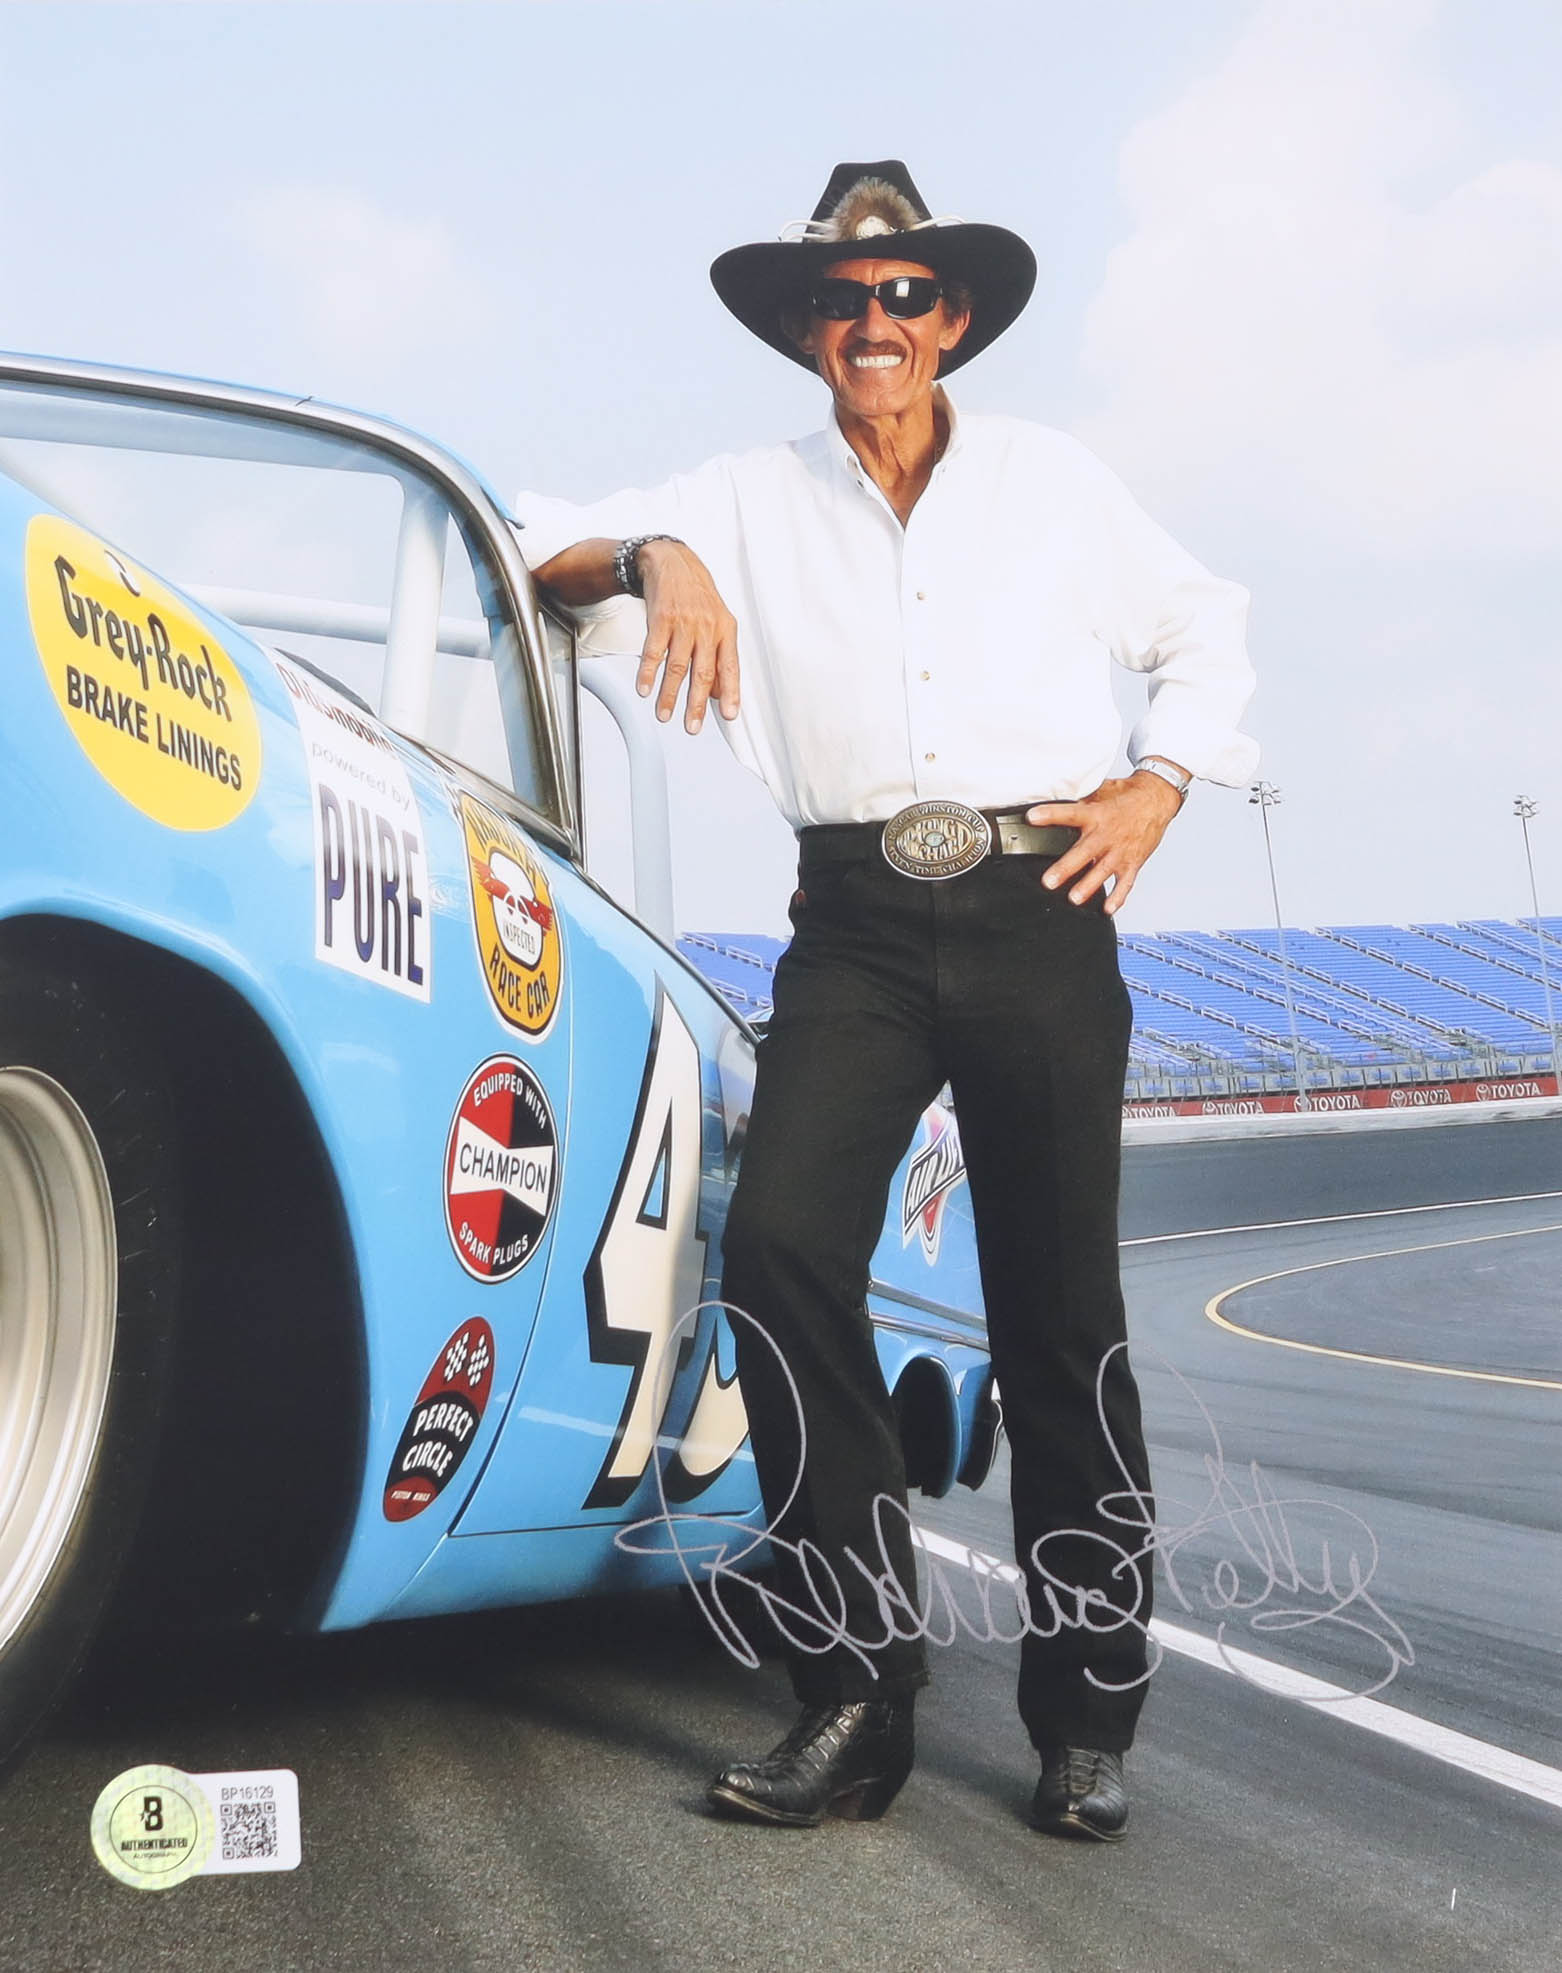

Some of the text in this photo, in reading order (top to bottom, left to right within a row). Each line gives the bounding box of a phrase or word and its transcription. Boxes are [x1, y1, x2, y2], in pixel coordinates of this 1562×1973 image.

[67, 664, 242, 791] BRAKE LININGS
[312, 743, 411, 811] powered by
[319, 783, 424, 986] PURE
[503, 920, 537, 956] INSPECTED
[489, 942, 551, 1019] RACE CAR
[474, 1073, 547, 1129] EQUIPPED WITH
[1216, 1101, 1265, 1114] TOYOTA
[1311, 1095, 1361, 1110] TOYOTA
[1406, 1088, 1452, 1105] TOYOTA
[1490, 1082, 1542, 1098] TOYOTA
[459, 1143, 548, 1194] CHAMPION
[459, 1221, 529, 1265] SPARK PLUGS
[412, 1402, 475, 1442] PERFECT
[402, 1440, 454, 1478] CIRCLE
[221, 1785, 274, 1800] BP16129
[120, 1837, 188, 1852] AUTHENTICATED
